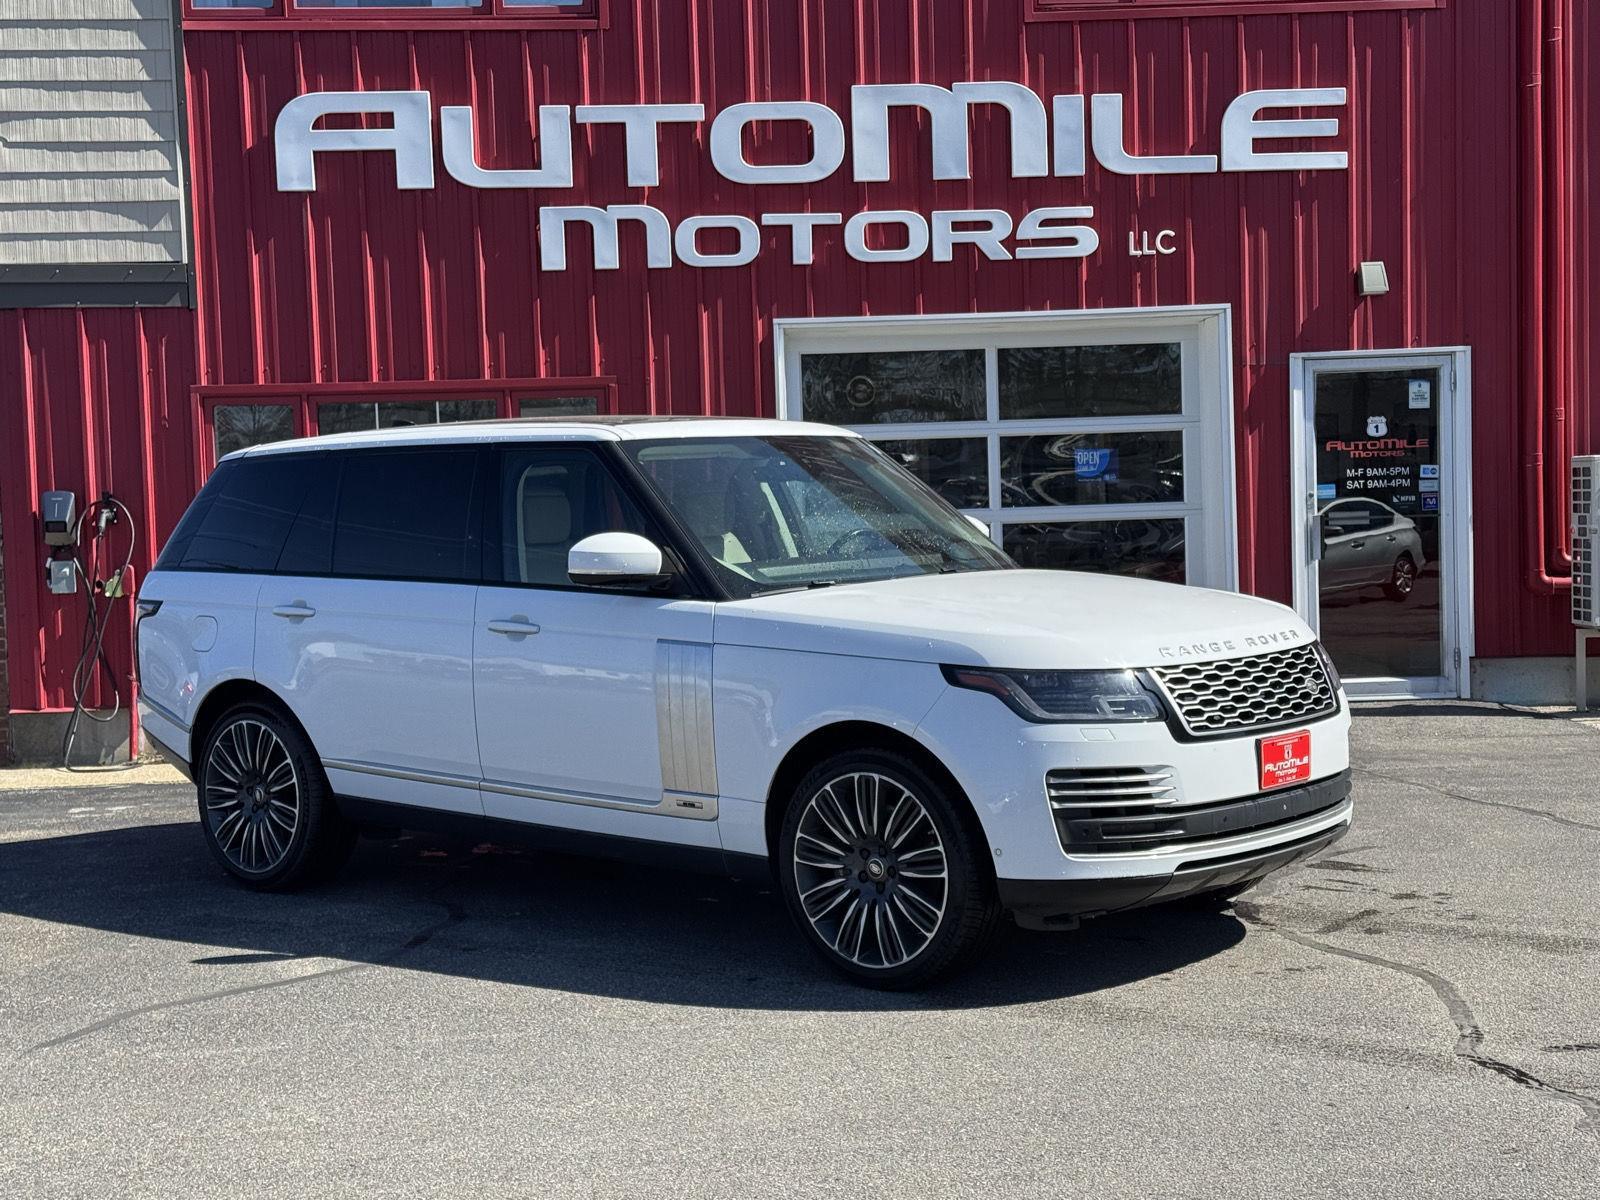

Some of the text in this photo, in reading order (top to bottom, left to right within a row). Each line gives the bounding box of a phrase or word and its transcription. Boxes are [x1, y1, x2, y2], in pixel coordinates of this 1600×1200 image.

[275, 81, 1349, 192] AUTOMILE
[539, 205, 1177, 271] MOTORS LLC
[1373, 424, 1379, 433] 1
[1326, 439, 1429, 451] AUTOMILE
[1077, 451, 1099, 464] OPEN
[1350, 450, 1405, 458] MOTORS
[1346, 466, 1410, 477] M-F 9AM-5PM
[1346, 480, 1364, 489] SAT
[1367, 478, 1411, 488] 9AM-4PM
[1158, 629, 1300, 658] RANGE ROVER
